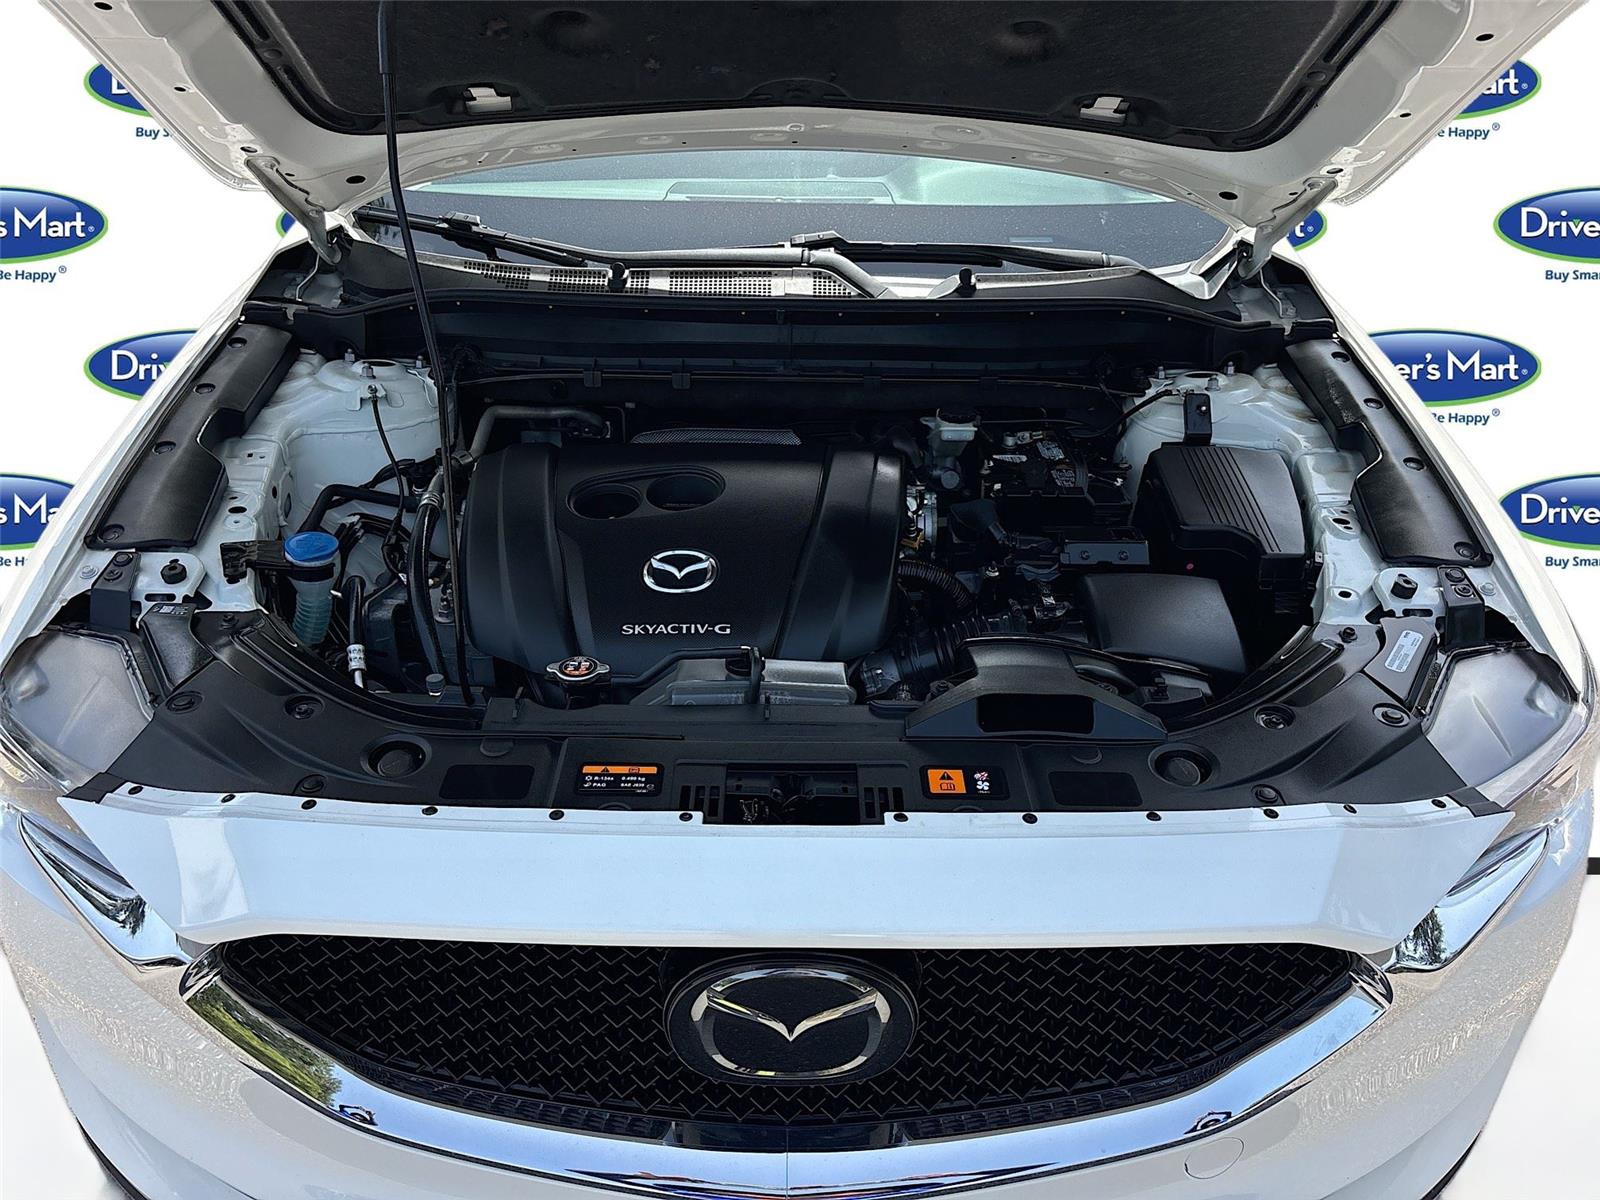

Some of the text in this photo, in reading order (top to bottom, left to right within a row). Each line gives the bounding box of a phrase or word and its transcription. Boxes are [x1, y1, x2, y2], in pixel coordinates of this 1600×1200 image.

[135, 126, 160, 140] Buy
[1520, 206, 1600, 238] Drive
[1545, 269, 1569, 283] Buy
[1394, 352, 1441, 381] er's
[1520, 493, 1600, 525] Drive
[1545, 556, 1569, 569] Buy
[621, 623, 731, 635] SKYACTIV-G
